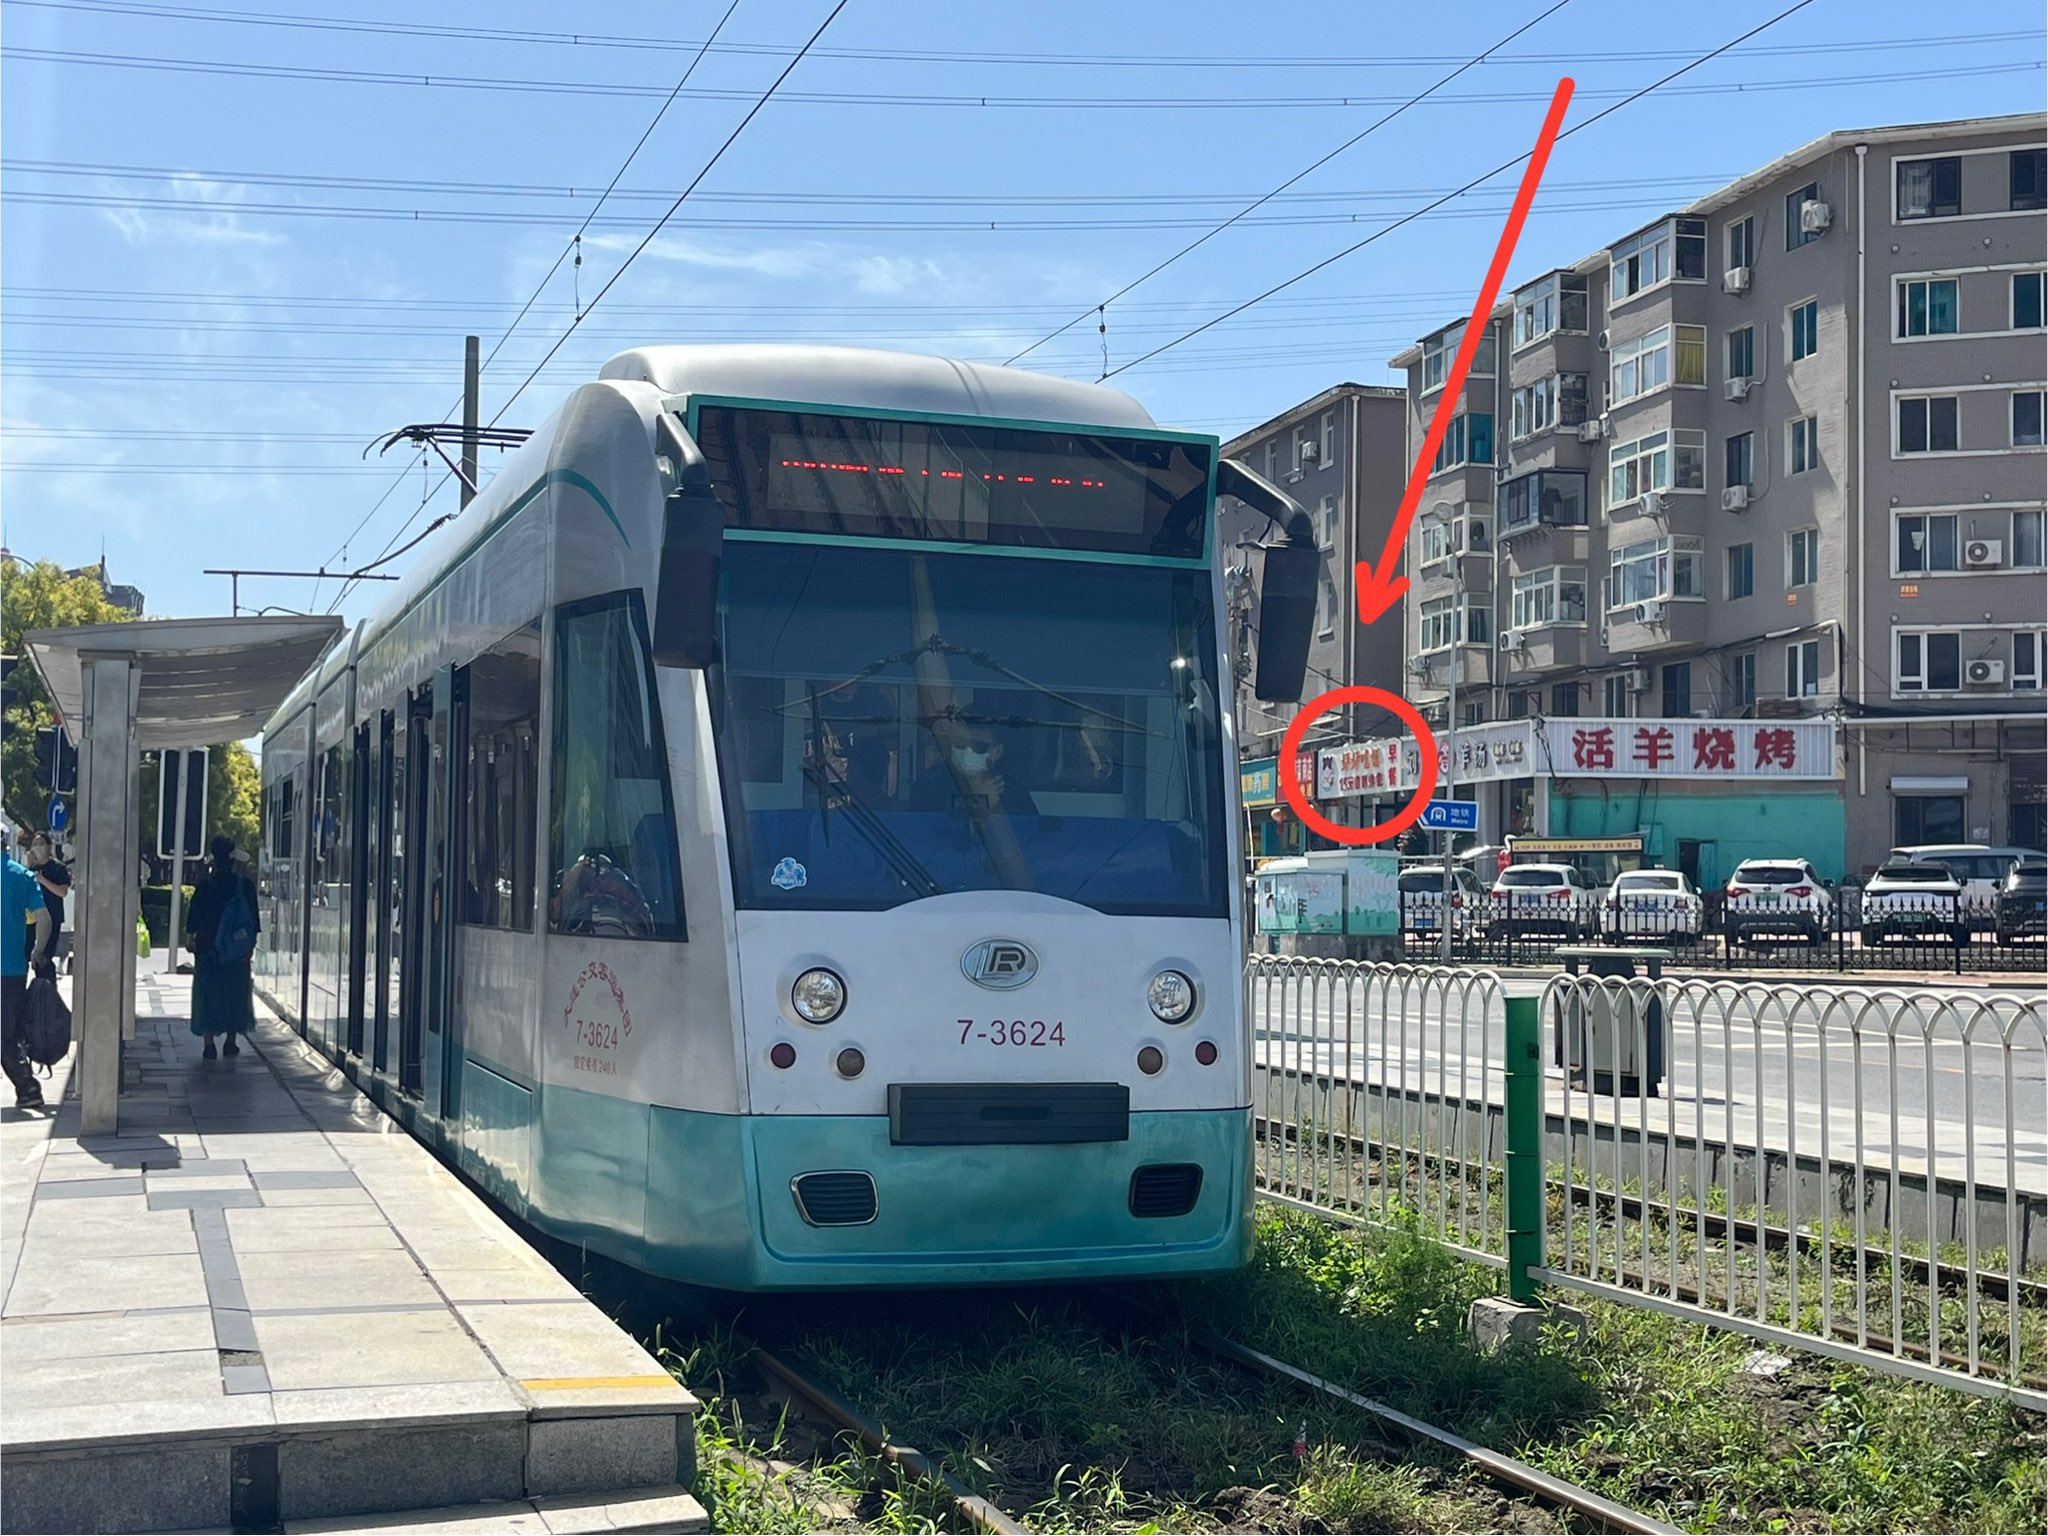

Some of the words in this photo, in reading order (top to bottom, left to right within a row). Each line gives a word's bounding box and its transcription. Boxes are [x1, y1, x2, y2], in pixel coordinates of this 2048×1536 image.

[1572, 727, 1796, 769] 活羊烧烤
[1451, 808, 1470, 817] 地铁
[576, 1020, 618, 1050] 7-3624
[957, 1019, 1066, 1046] 7-3624
